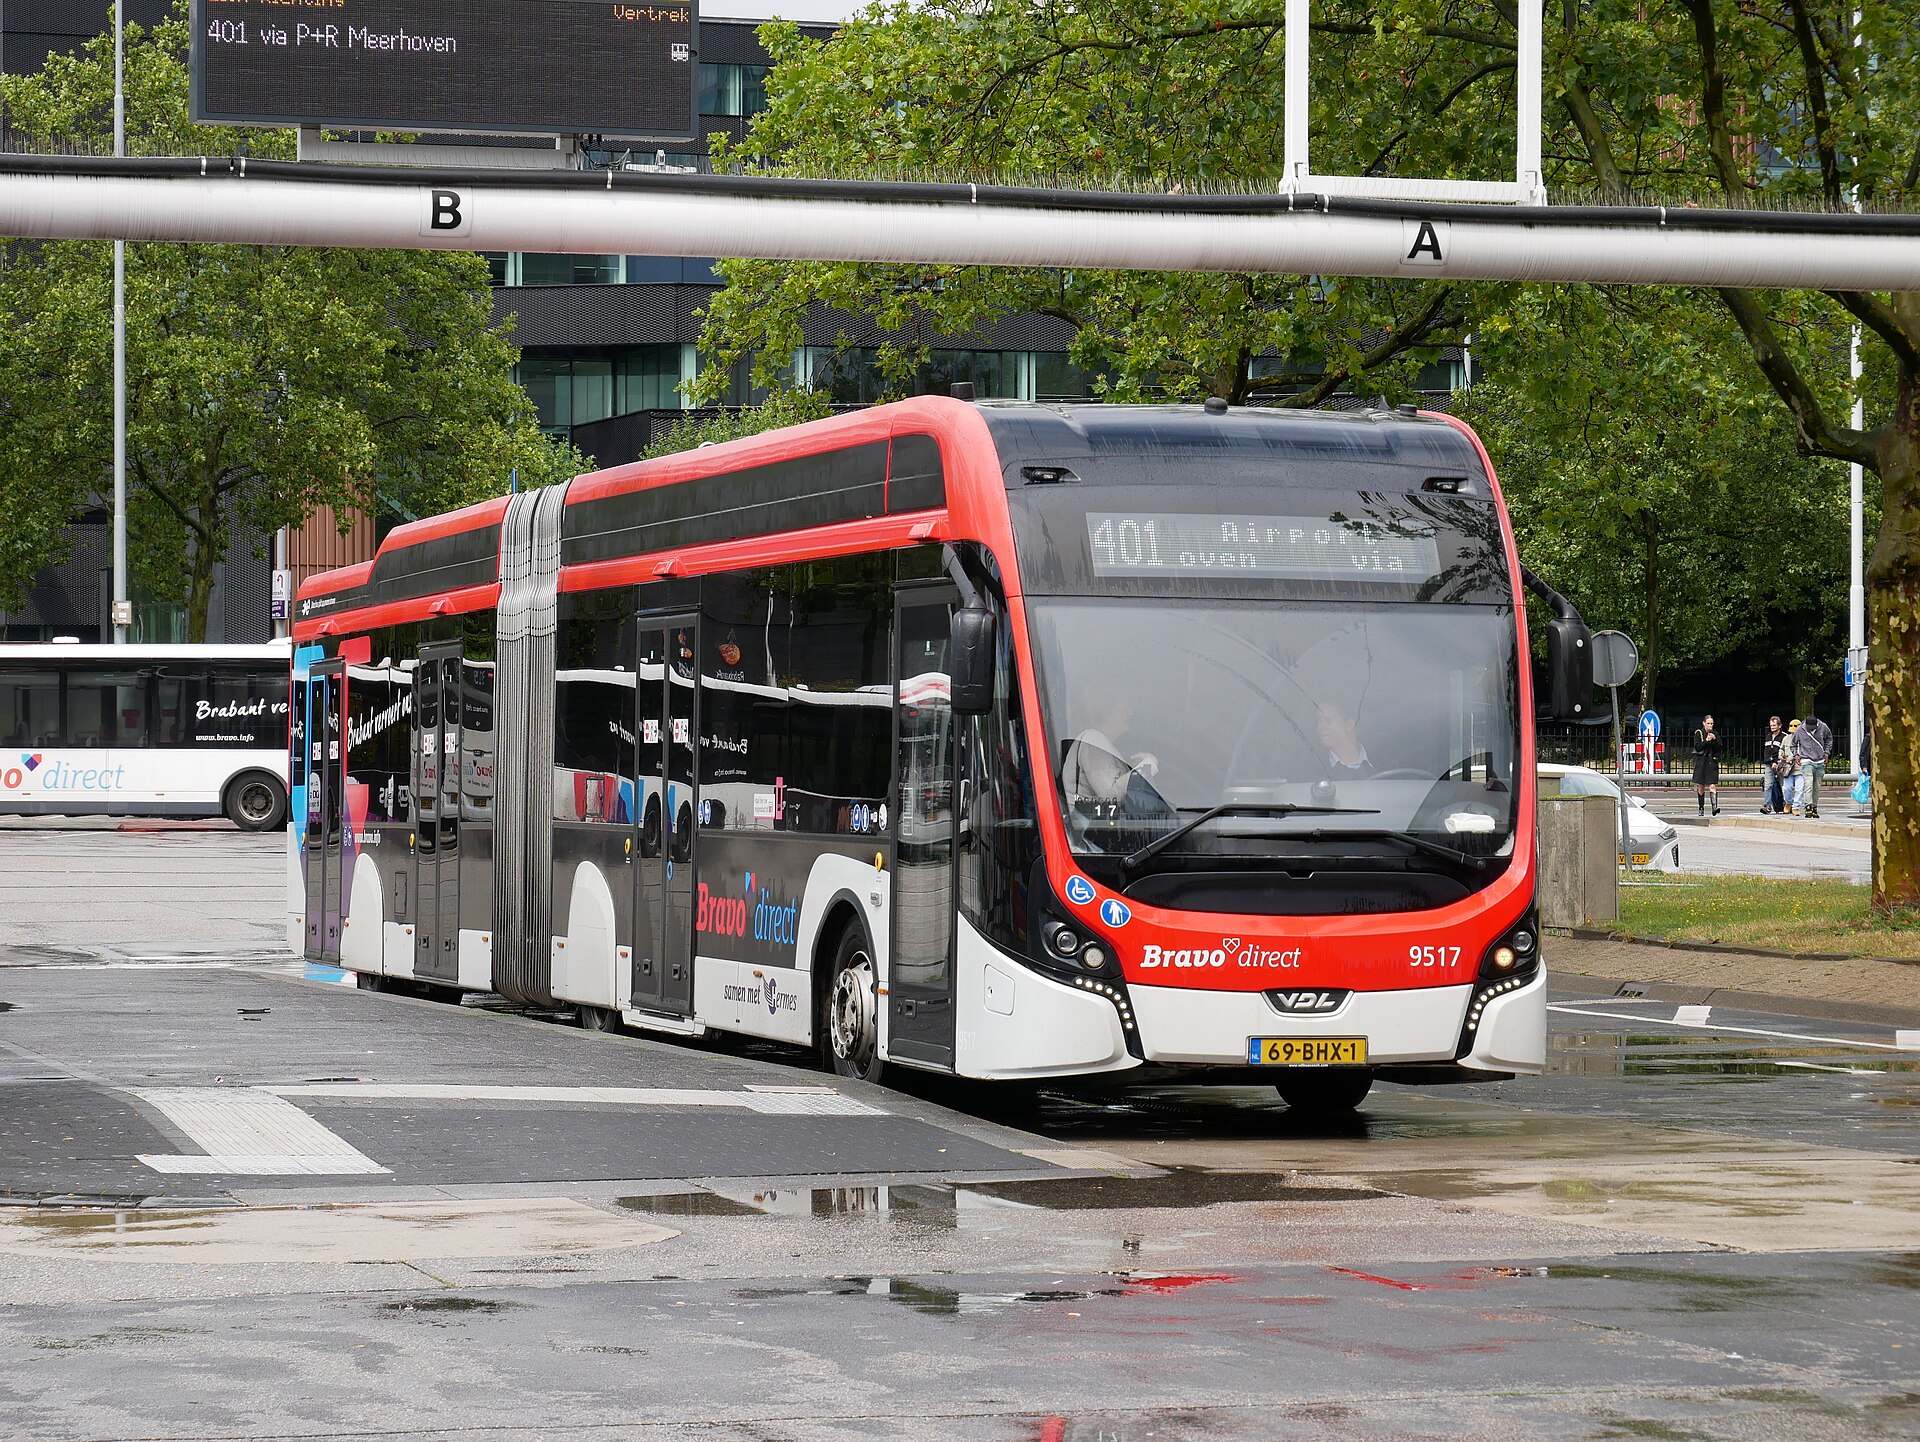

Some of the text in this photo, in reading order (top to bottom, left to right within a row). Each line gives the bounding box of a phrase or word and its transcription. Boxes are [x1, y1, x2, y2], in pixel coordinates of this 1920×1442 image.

[614, 4, 689, 22] Vertrek
[208, 19, 456, 52] 401 via P+R Meerhoven
[431, 190, 462, 229] B
[1407, 222, 1442, 260] A
[1094, 519, 1163, 566] 401
[1221, 521, 1377, 545] Airport
[1179, 550, 1403, 570] oven via
[196, 698, 267, 720] Brabant
[195, 734, 254, 743] www.bravo.info
[42, 761, 124, 789] direct
[696, 882, 796, 945] Bravo direct
[1140, 944, 1301, 968] Bravo direct
[1409, 945, 1461, 967] 9517
[724, 984, 746, 1002] samen
[747, 985, 761, 1005] met
[1277, 992, 1336, 1009] VDL
[1268, 1042, 1356, 1060] 69-BHX-1
